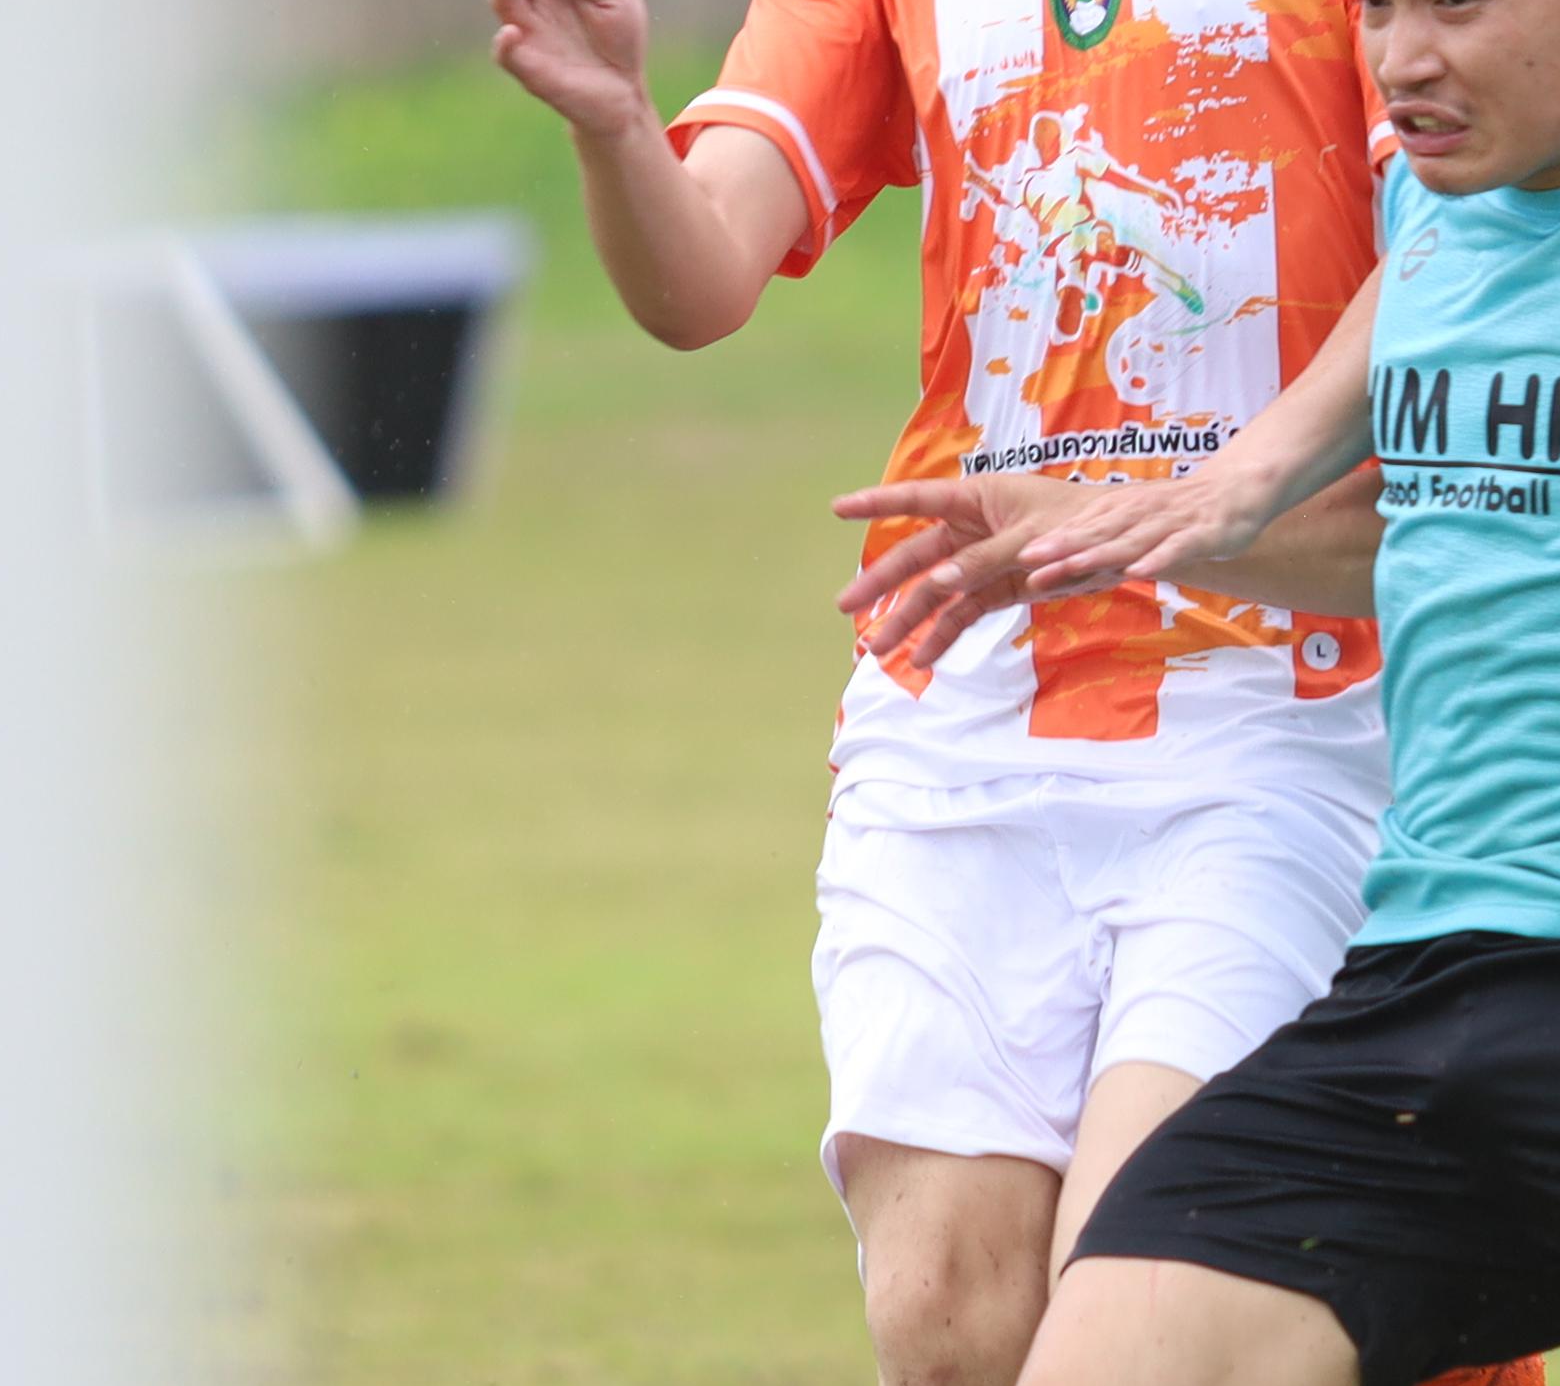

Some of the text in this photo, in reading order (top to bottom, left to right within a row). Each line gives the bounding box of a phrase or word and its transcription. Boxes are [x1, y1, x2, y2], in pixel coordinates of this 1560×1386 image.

[1371, 365, 1450, 455] IM
[1429, 474, 1550, 516] Football
[1316, 643, 1327, 658] L
